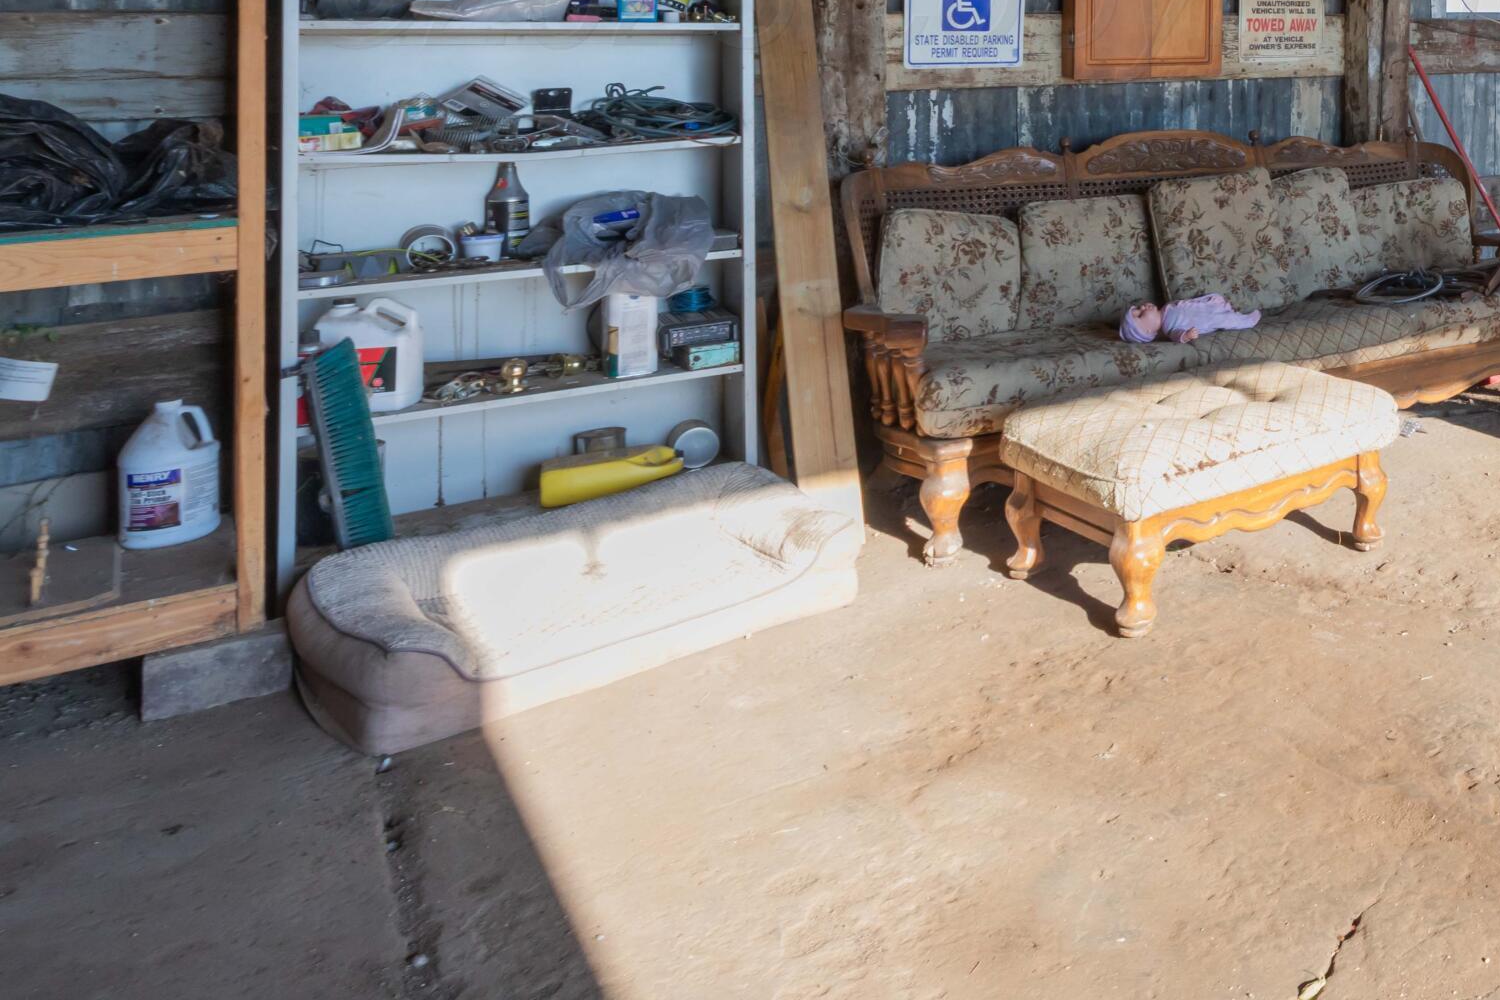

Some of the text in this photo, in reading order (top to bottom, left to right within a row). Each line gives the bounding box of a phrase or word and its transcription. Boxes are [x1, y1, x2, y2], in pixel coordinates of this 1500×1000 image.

[1246, 18, 1318, 33] TOWED AWAY
[914, 34, 1014, 46] STATE DISABLED PARKING
[931, 47, 999, 59] PERMIT REQUIRED
